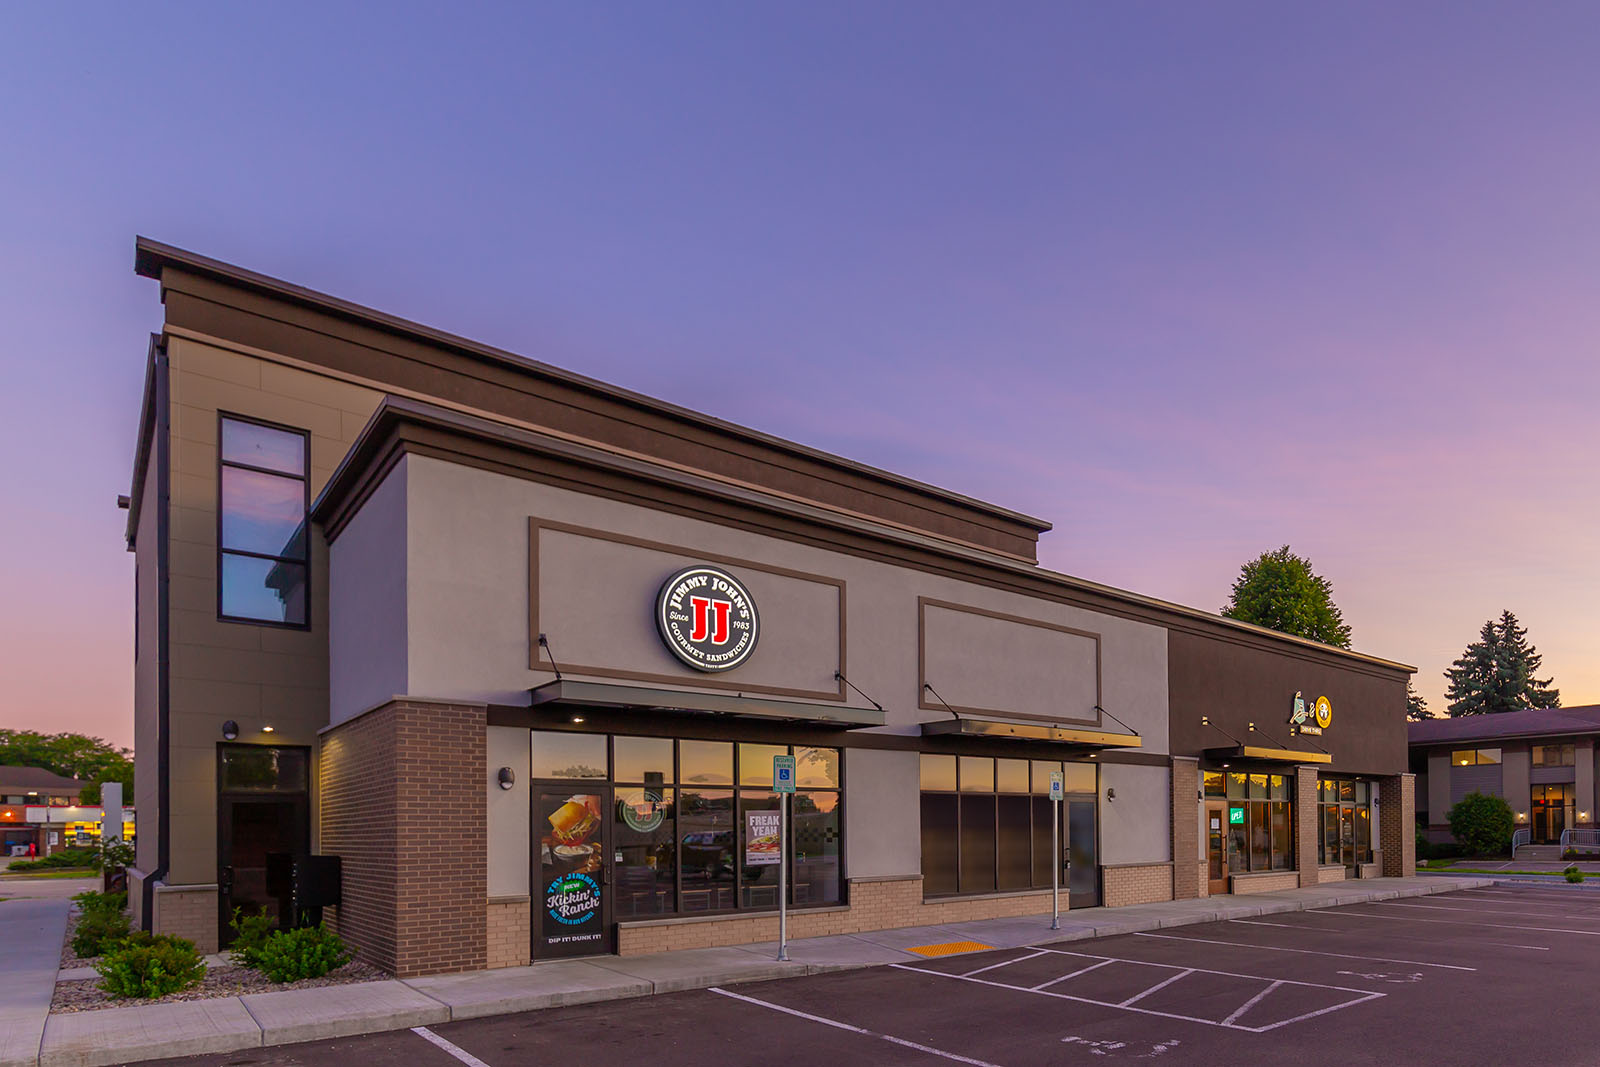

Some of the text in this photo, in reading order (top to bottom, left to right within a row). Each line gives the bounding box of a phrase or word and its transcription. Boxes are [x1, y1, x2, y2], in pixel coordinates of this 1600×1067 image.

[669, 575, 750, 620] JIMMY JOHN'S
[669, 611, 689, 622] Since
[690, 595, 732, 645] JJ
[733, 620, 750, 630] 1983
[670, 622, 750, 662] GOURMET SANDWICHES
[749, 815, 780, 826] FREAK
[752, 826, 777, 837] YEAH
[547, 876, 563, 894] TRY
[547, 889, 590, 908] Kickin'
